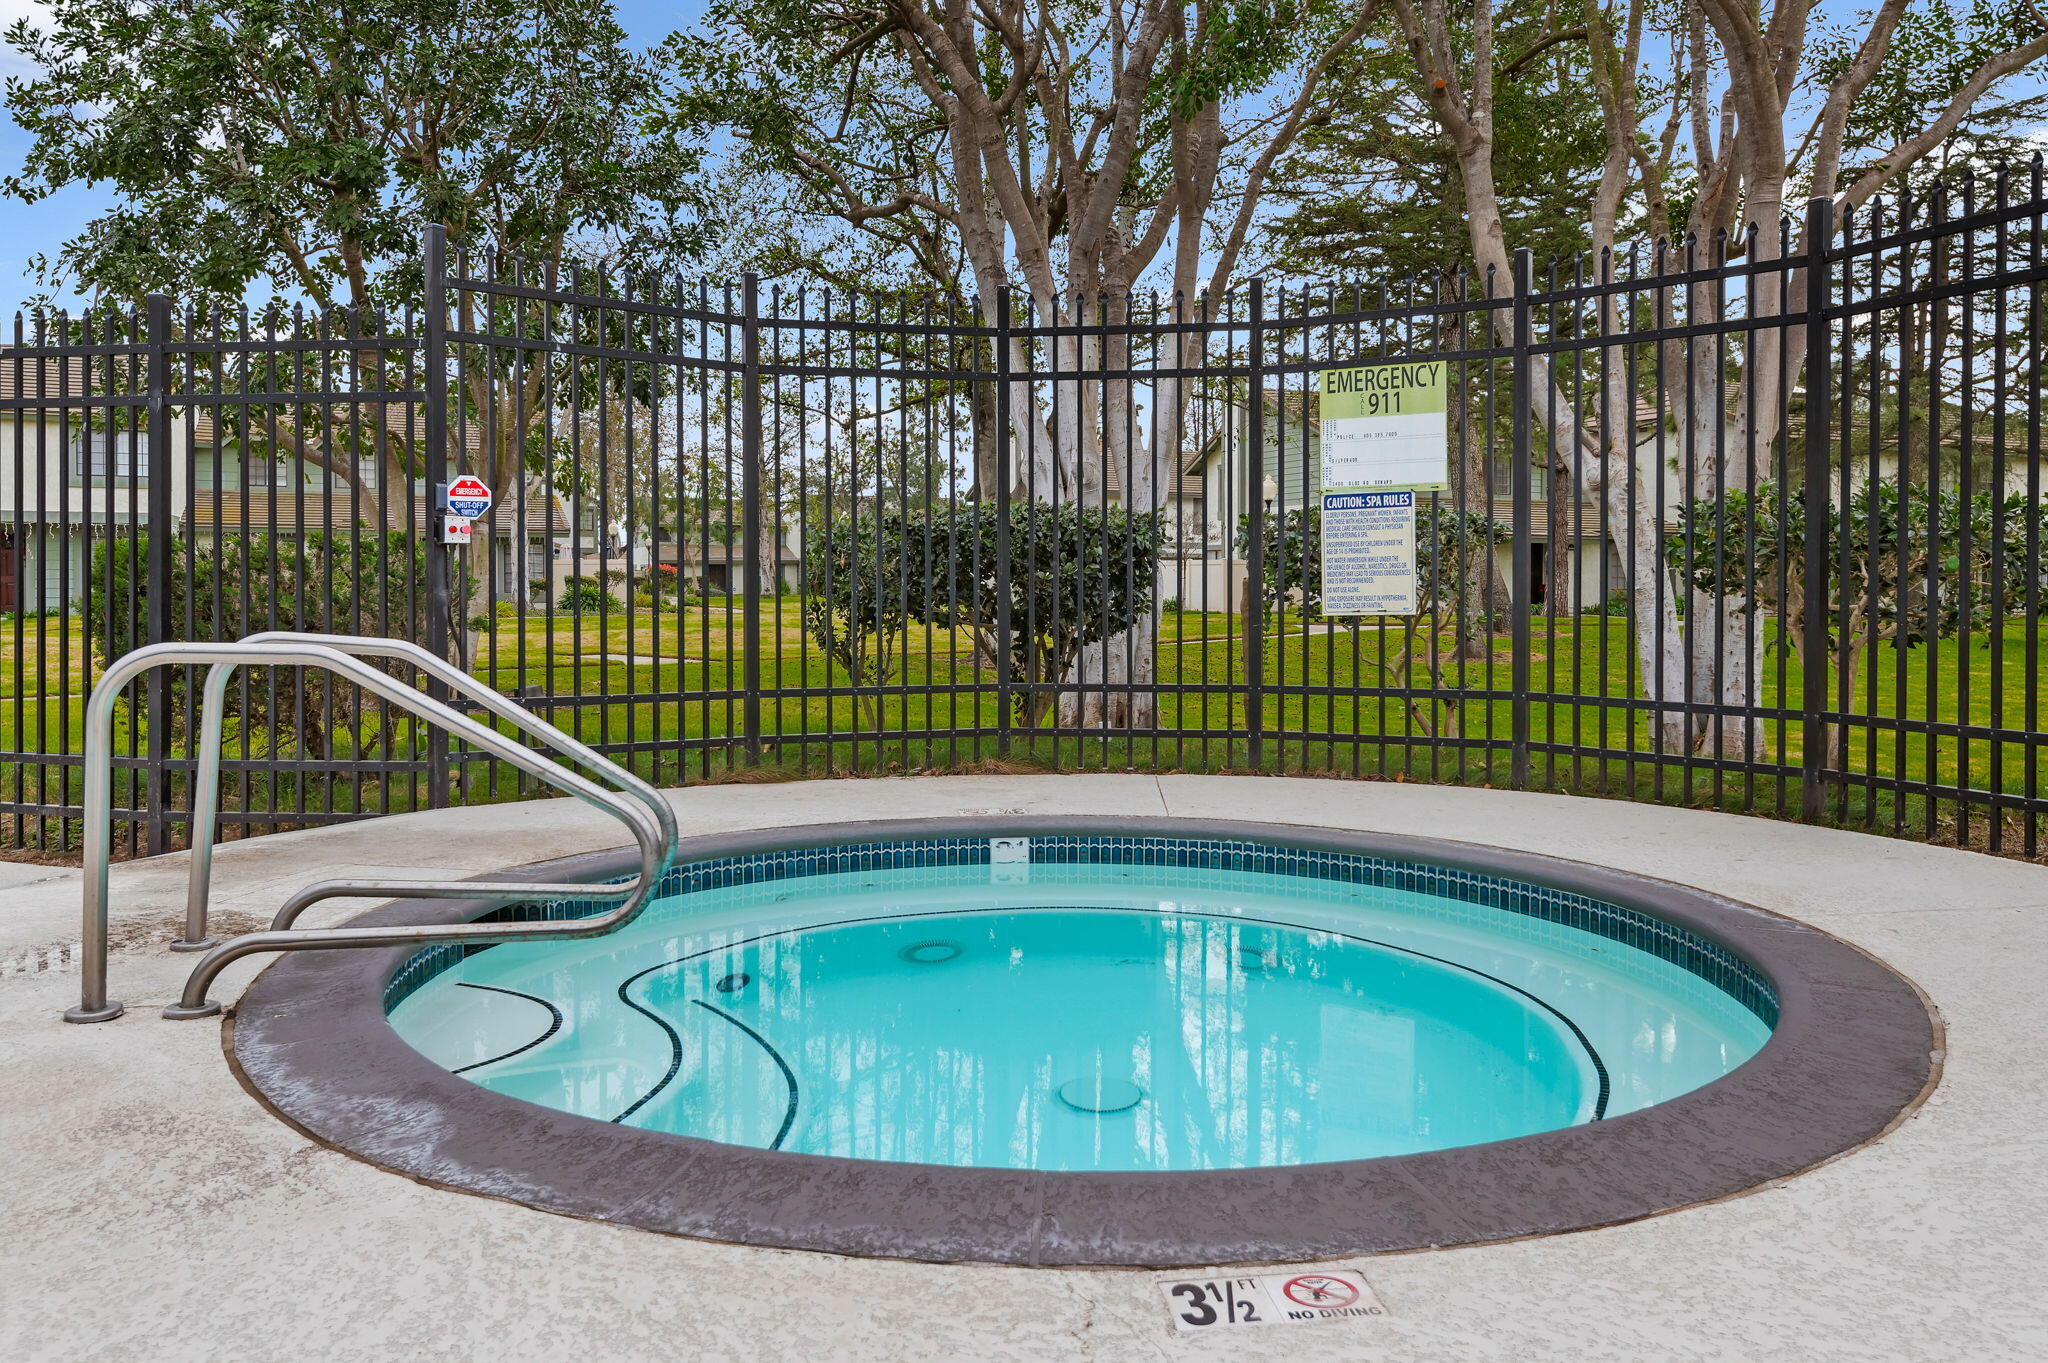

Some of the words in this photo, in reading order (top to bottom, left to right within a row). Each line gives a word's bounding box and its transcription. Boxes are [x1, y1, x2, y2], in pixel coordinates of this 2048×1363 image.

[1326, 364, 1439, 394] EMERGENCY
[1368, 392, 1400, 414] 911
[1326, 496, 1364, 508] CAUTION:
[1366, 495, 1381, 506] SPA
[1383, 494, 1409, 505] RULES
[1236, 1278, 1256, 1290] FT
[1288, 1309, 1314, 1320] NO
[1318, 1306, 1382, 1318] DIVING
